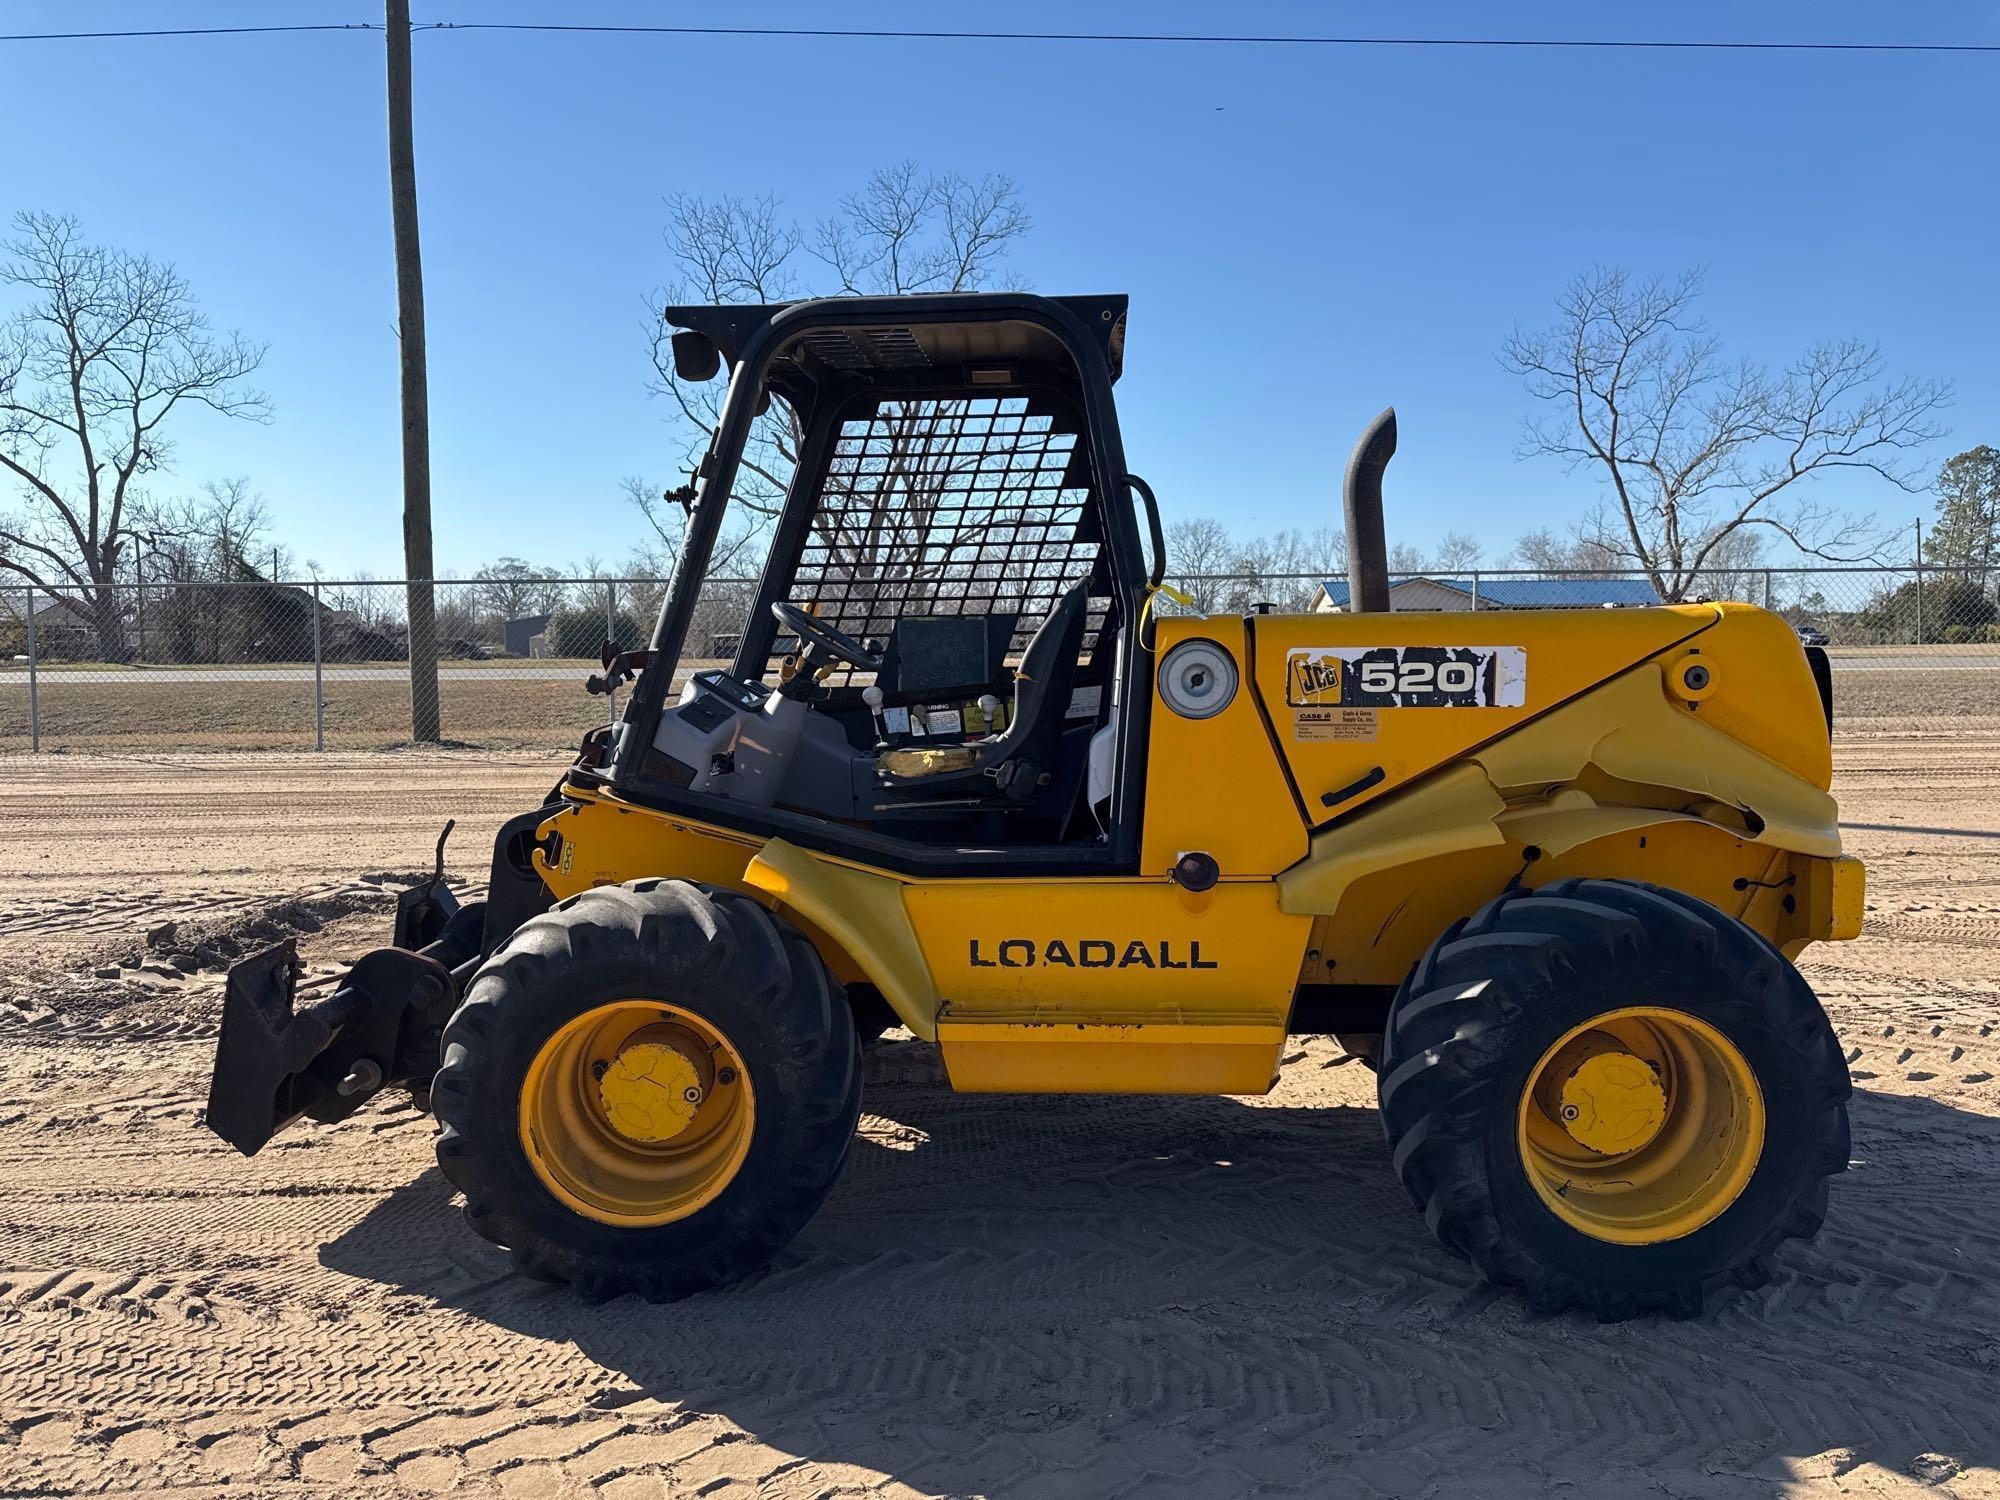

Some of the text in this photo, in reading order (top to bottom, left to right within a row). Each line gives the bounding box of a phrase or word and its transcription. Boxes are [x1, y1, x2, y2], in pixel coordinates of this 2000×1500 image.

[1300, 663, 1337, 692] JCB
[1360, 661, 1475, 693] 520
[970, 939, 1218, 968] LOADALL
